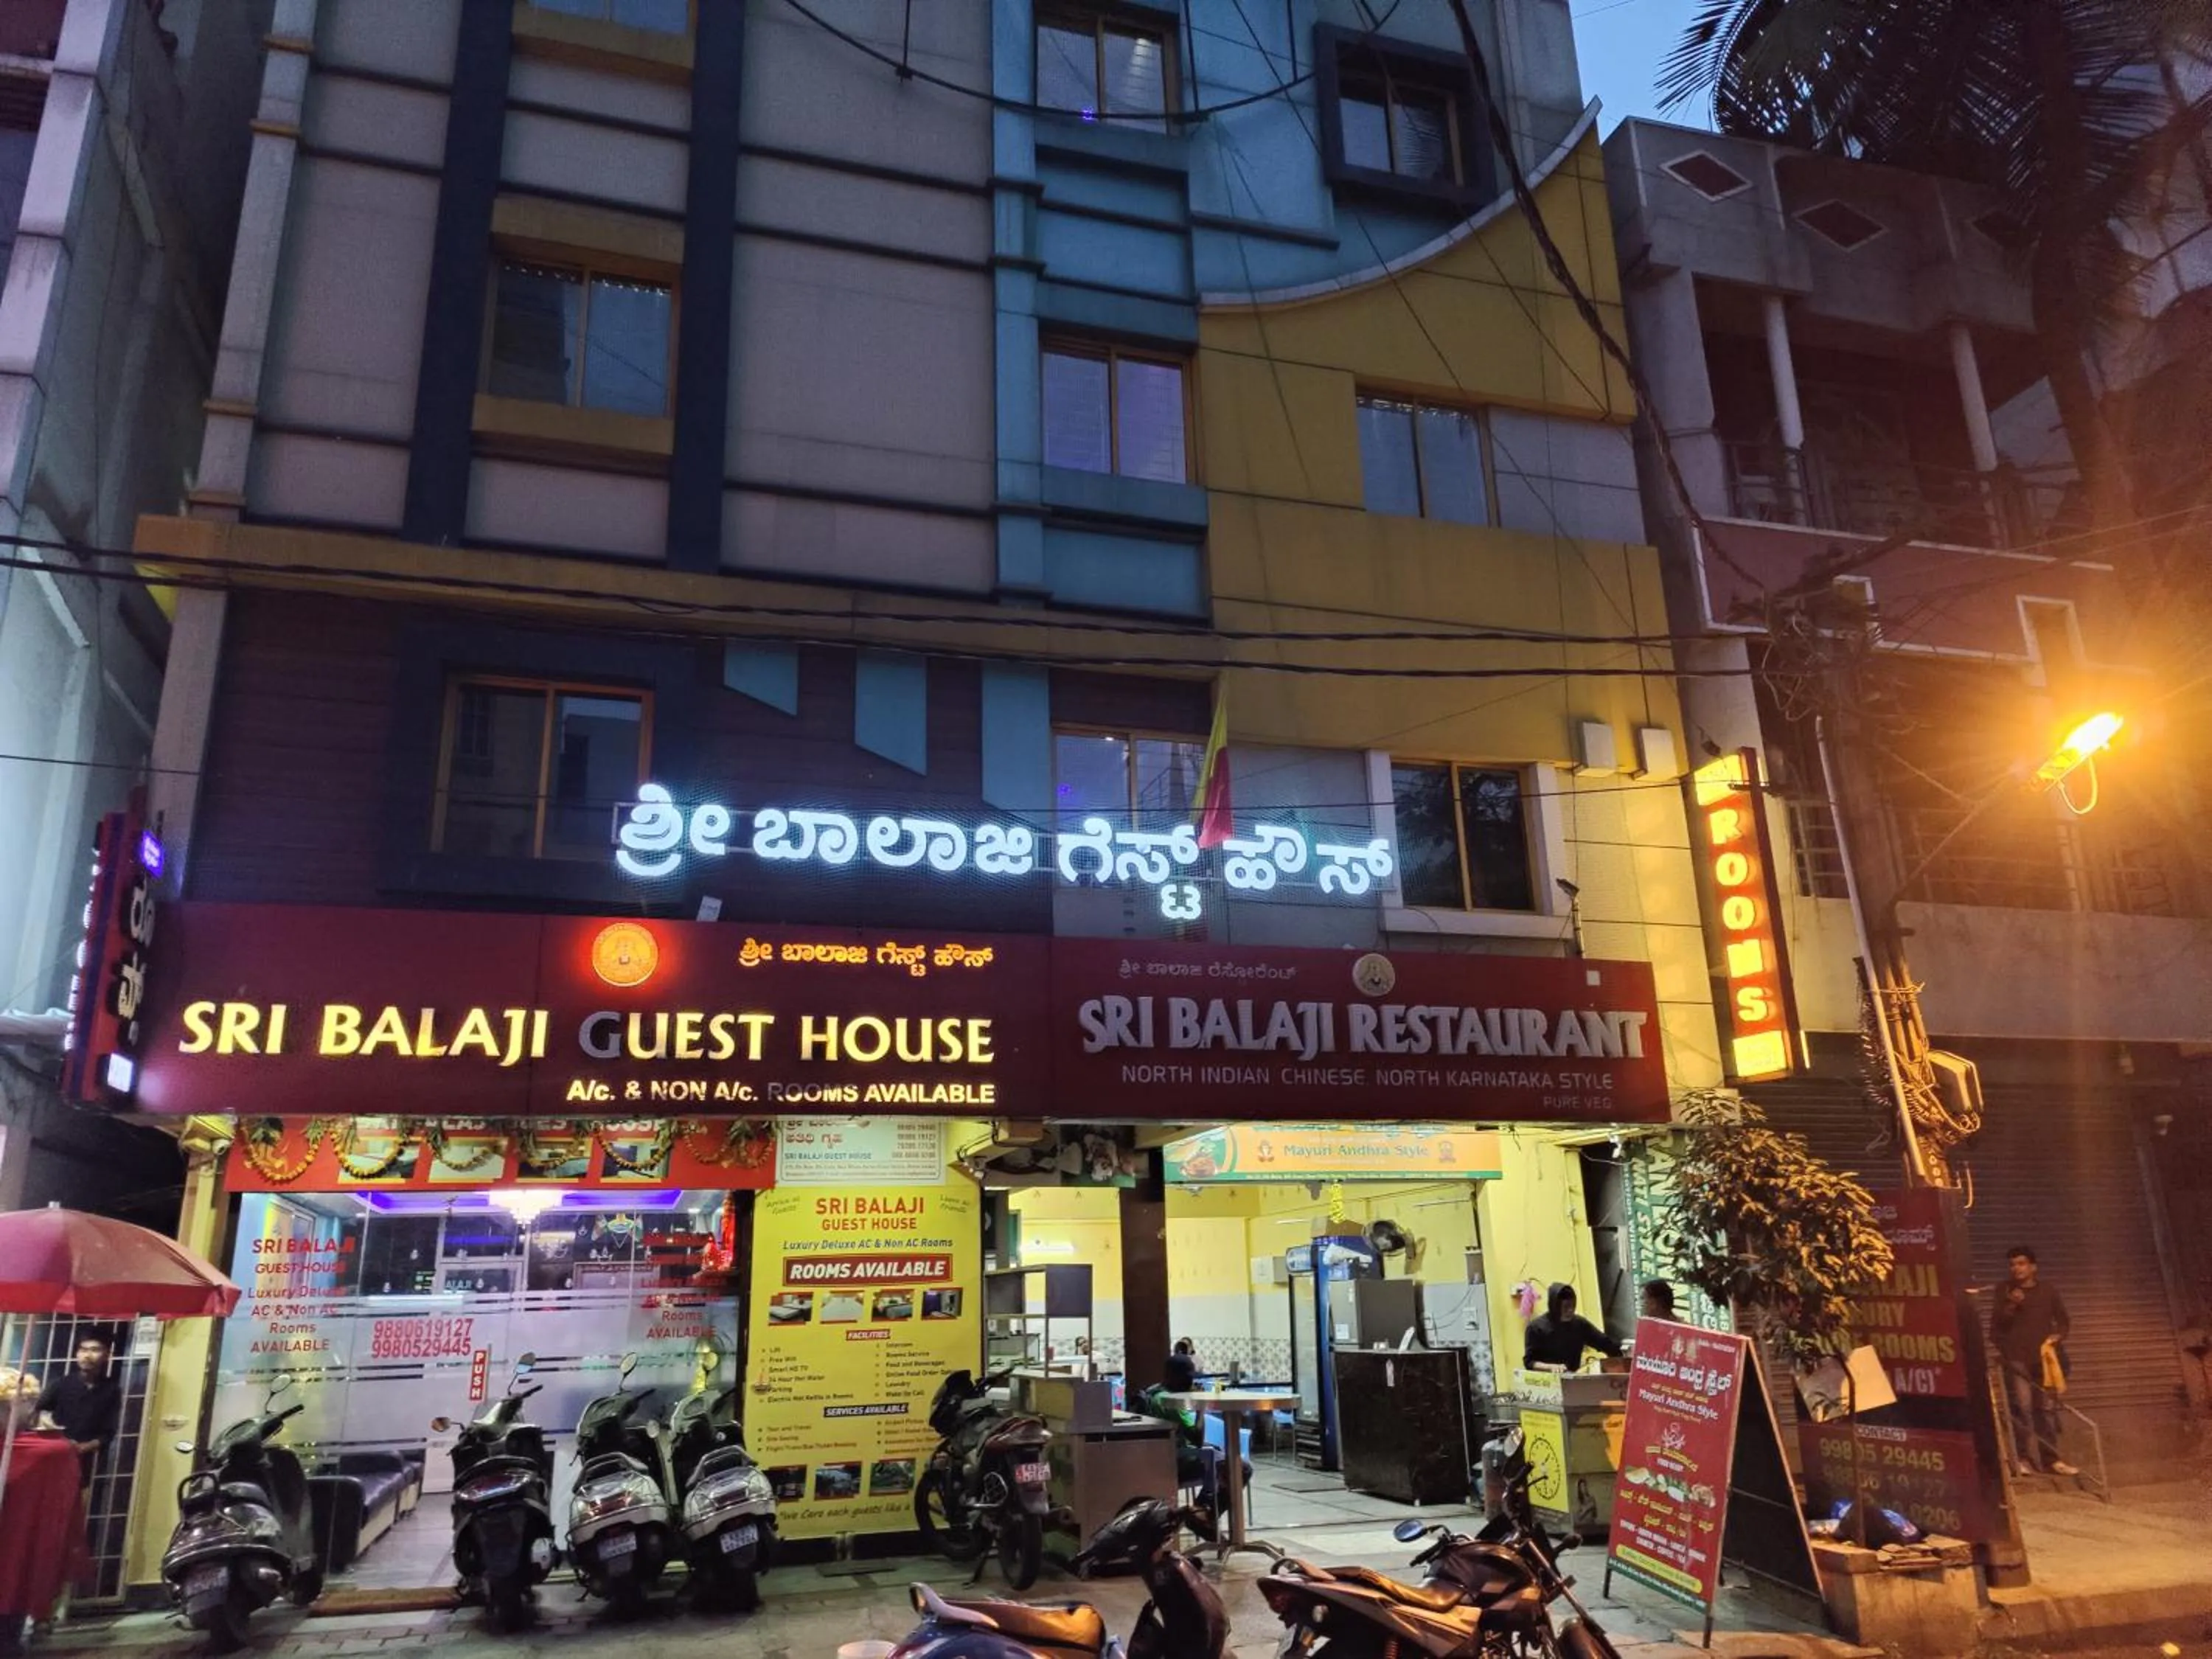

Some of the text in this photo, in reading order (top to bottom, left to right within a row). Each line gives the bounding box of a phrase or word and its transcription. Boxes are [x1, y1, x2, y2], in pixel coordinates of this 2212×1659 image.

[617, 782, 731, 877] ಶ್ರೀ
[753, 807, 1033, 872] ಬಾಲಾಜಿ
[1057, 818, 1200, 920] ಗೆಸ್ಟ್
[739, 936, 773, 967] ಶ್ರೀ
[782, 942, 869, 964] ಬಾಲಾಜಿ
[178, 1001, 995, 1067] SRI BALAJI GUEST HOUSE
[1077, 995, 1649, 1062] SRI BALAJI RESTAURANT
[1121, 1065, 1613, 1090] NORTH INDIAN CHINESE NORTH KARNATAKA STYLE
[625, 1080, 641, 1100] &
[650, 1081, 707, 1102] NON
[768, 1082, 860, 1104] ROOMS
[864, 1082, 995, 1105] AVAILABLE
[1283, 1144, 1429, 1158] Mayuri Andhra Style
[815, 1197, 925, 1215] SRI BALAJI
[822, 1217, 917, 1231] GUEST HOUSE
[252, 1238, 282, 1253] SRI
[782, 1238, 953, 1252] Luxury Deluxe AC & Non AC Rooms
[790, 1260, 946, 1280] ROOMS AVAILABLE
[248, 1287, 295, 1299] Luxury
[251, 1304, 271, 1316] AC
[275, 1304, 285, 1316] &
[269, 1322, 316, 1334] Rooms
[251, 1338, 330, 1354] AVAILABLE
[471, 1352, 485, 1398] PUSH
[825, 1404, 907, 1416] SERVICES AVAILABLE
[1666, 1397, 1696, 1413] Andhra
[1697, 1404, 1719, 1420] Style
[1882, 1445, 1945, 1472] 29445
